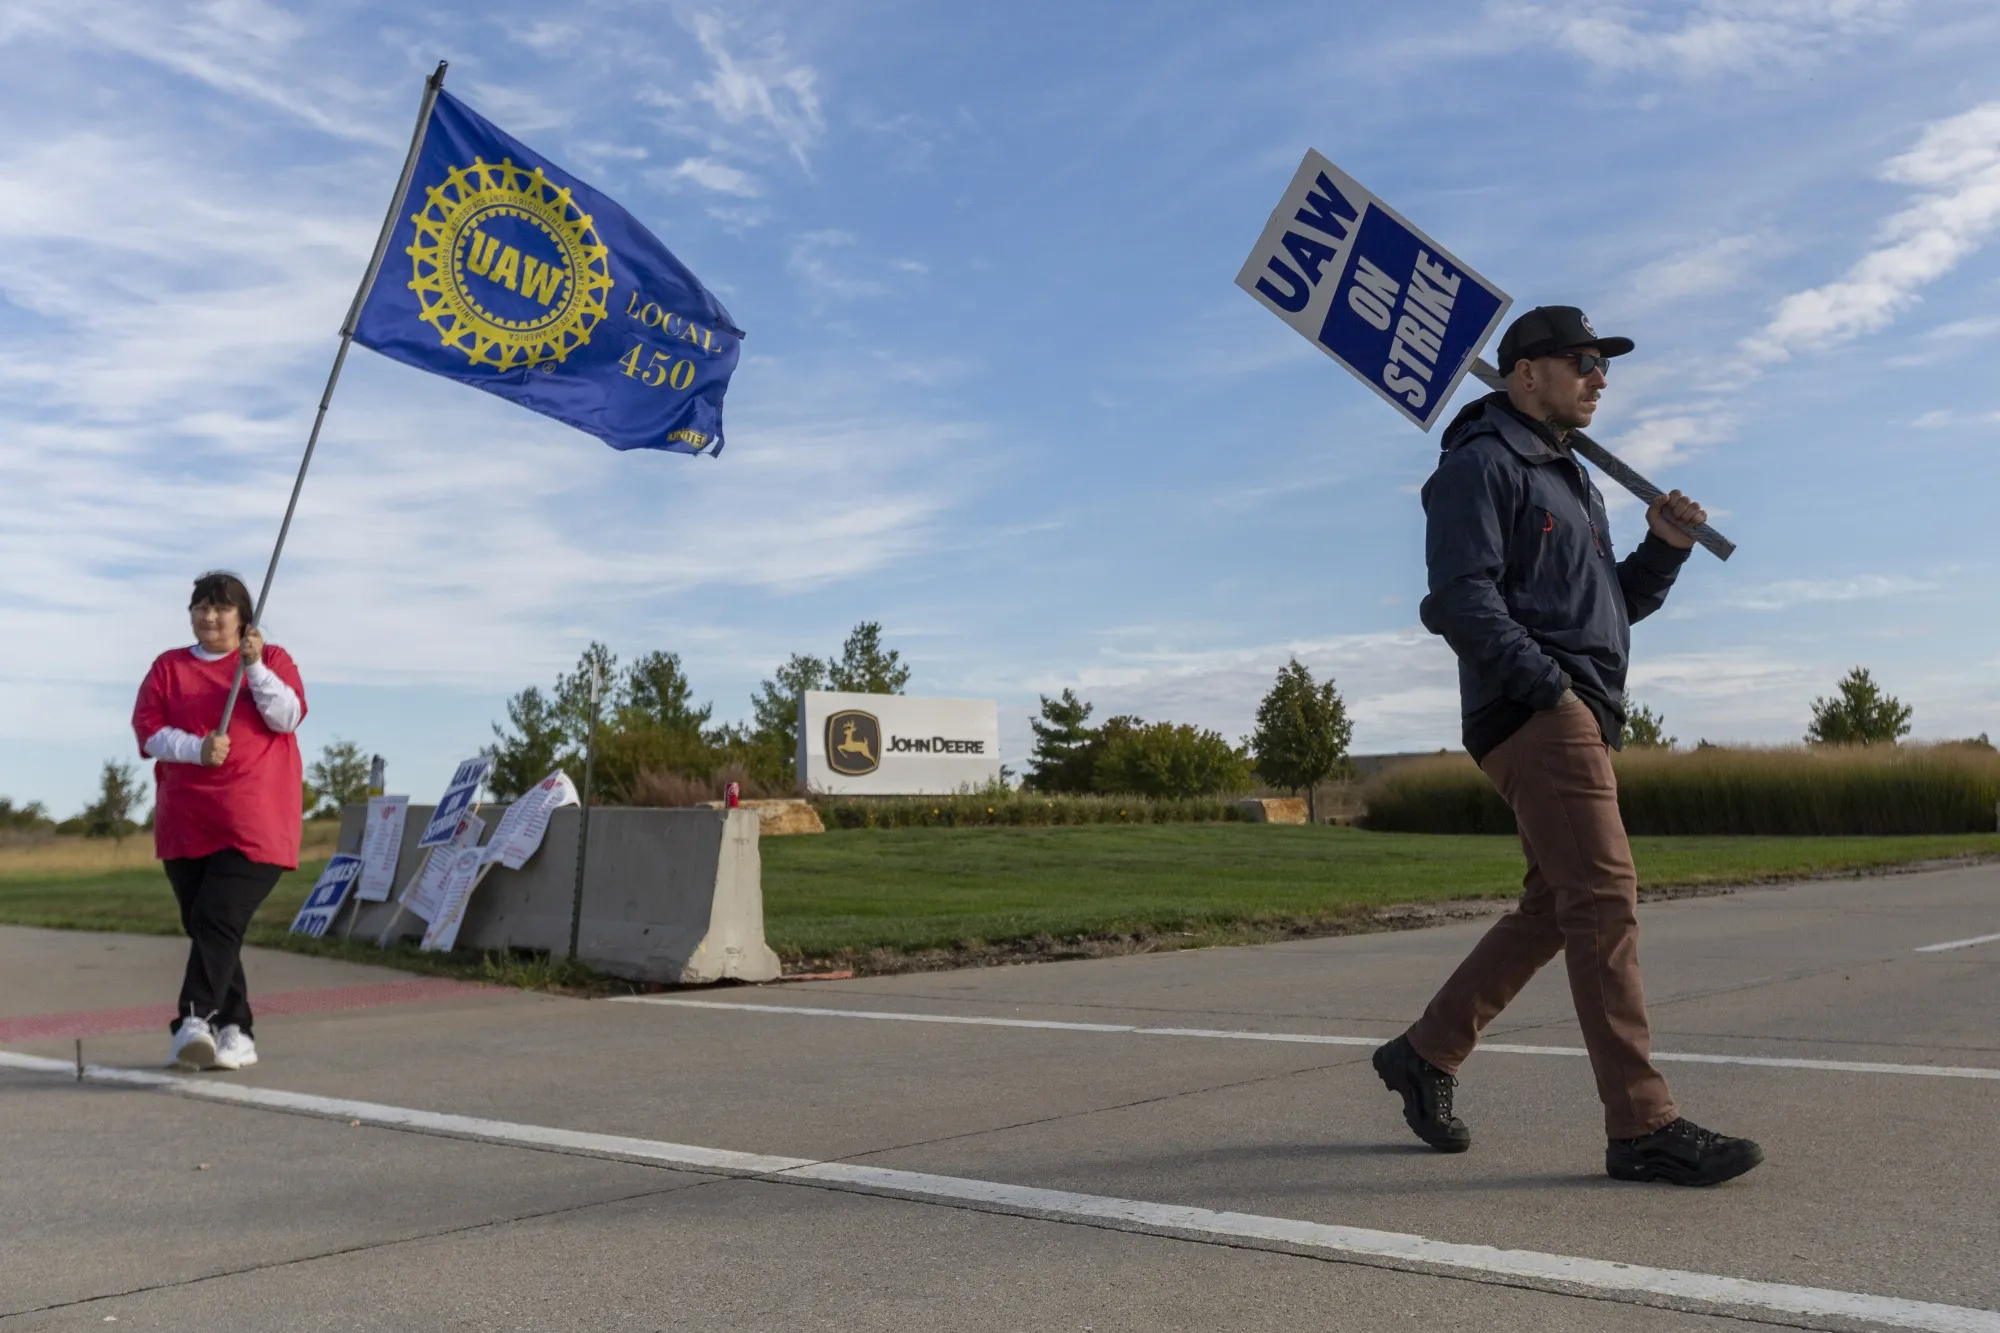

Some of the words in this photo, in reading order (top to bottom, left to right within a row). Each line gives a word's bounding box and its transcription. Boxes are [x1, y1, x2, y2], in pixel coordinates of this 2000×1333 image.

[450, 197, 487, 233] AEROSPACE
[489, 194, 505, 203] AND
[507, 195, 565, 233] AGRICULTURAL
[564, 234, 585, 286] IMPLEMENT
[1255, 170, 1359, 313] UAW
[466, 229, 566, 307] UAW
[451, 294, 475, 323] UNITED
[560, 289, 583, 327] WORKERS
[1348, 255, 1401, 331] ON
[508, 329, 547, 342] AMERICA
[550, 324, 560, 334] OF
[625, 291, 723, 353] LOCAL
[1383, 249, 1462, 409] STRIKE
[618, 343, 696, 391] 450
[886, 735, 931, 754] JOHN
[932, 736, 985, 755] DEERE
